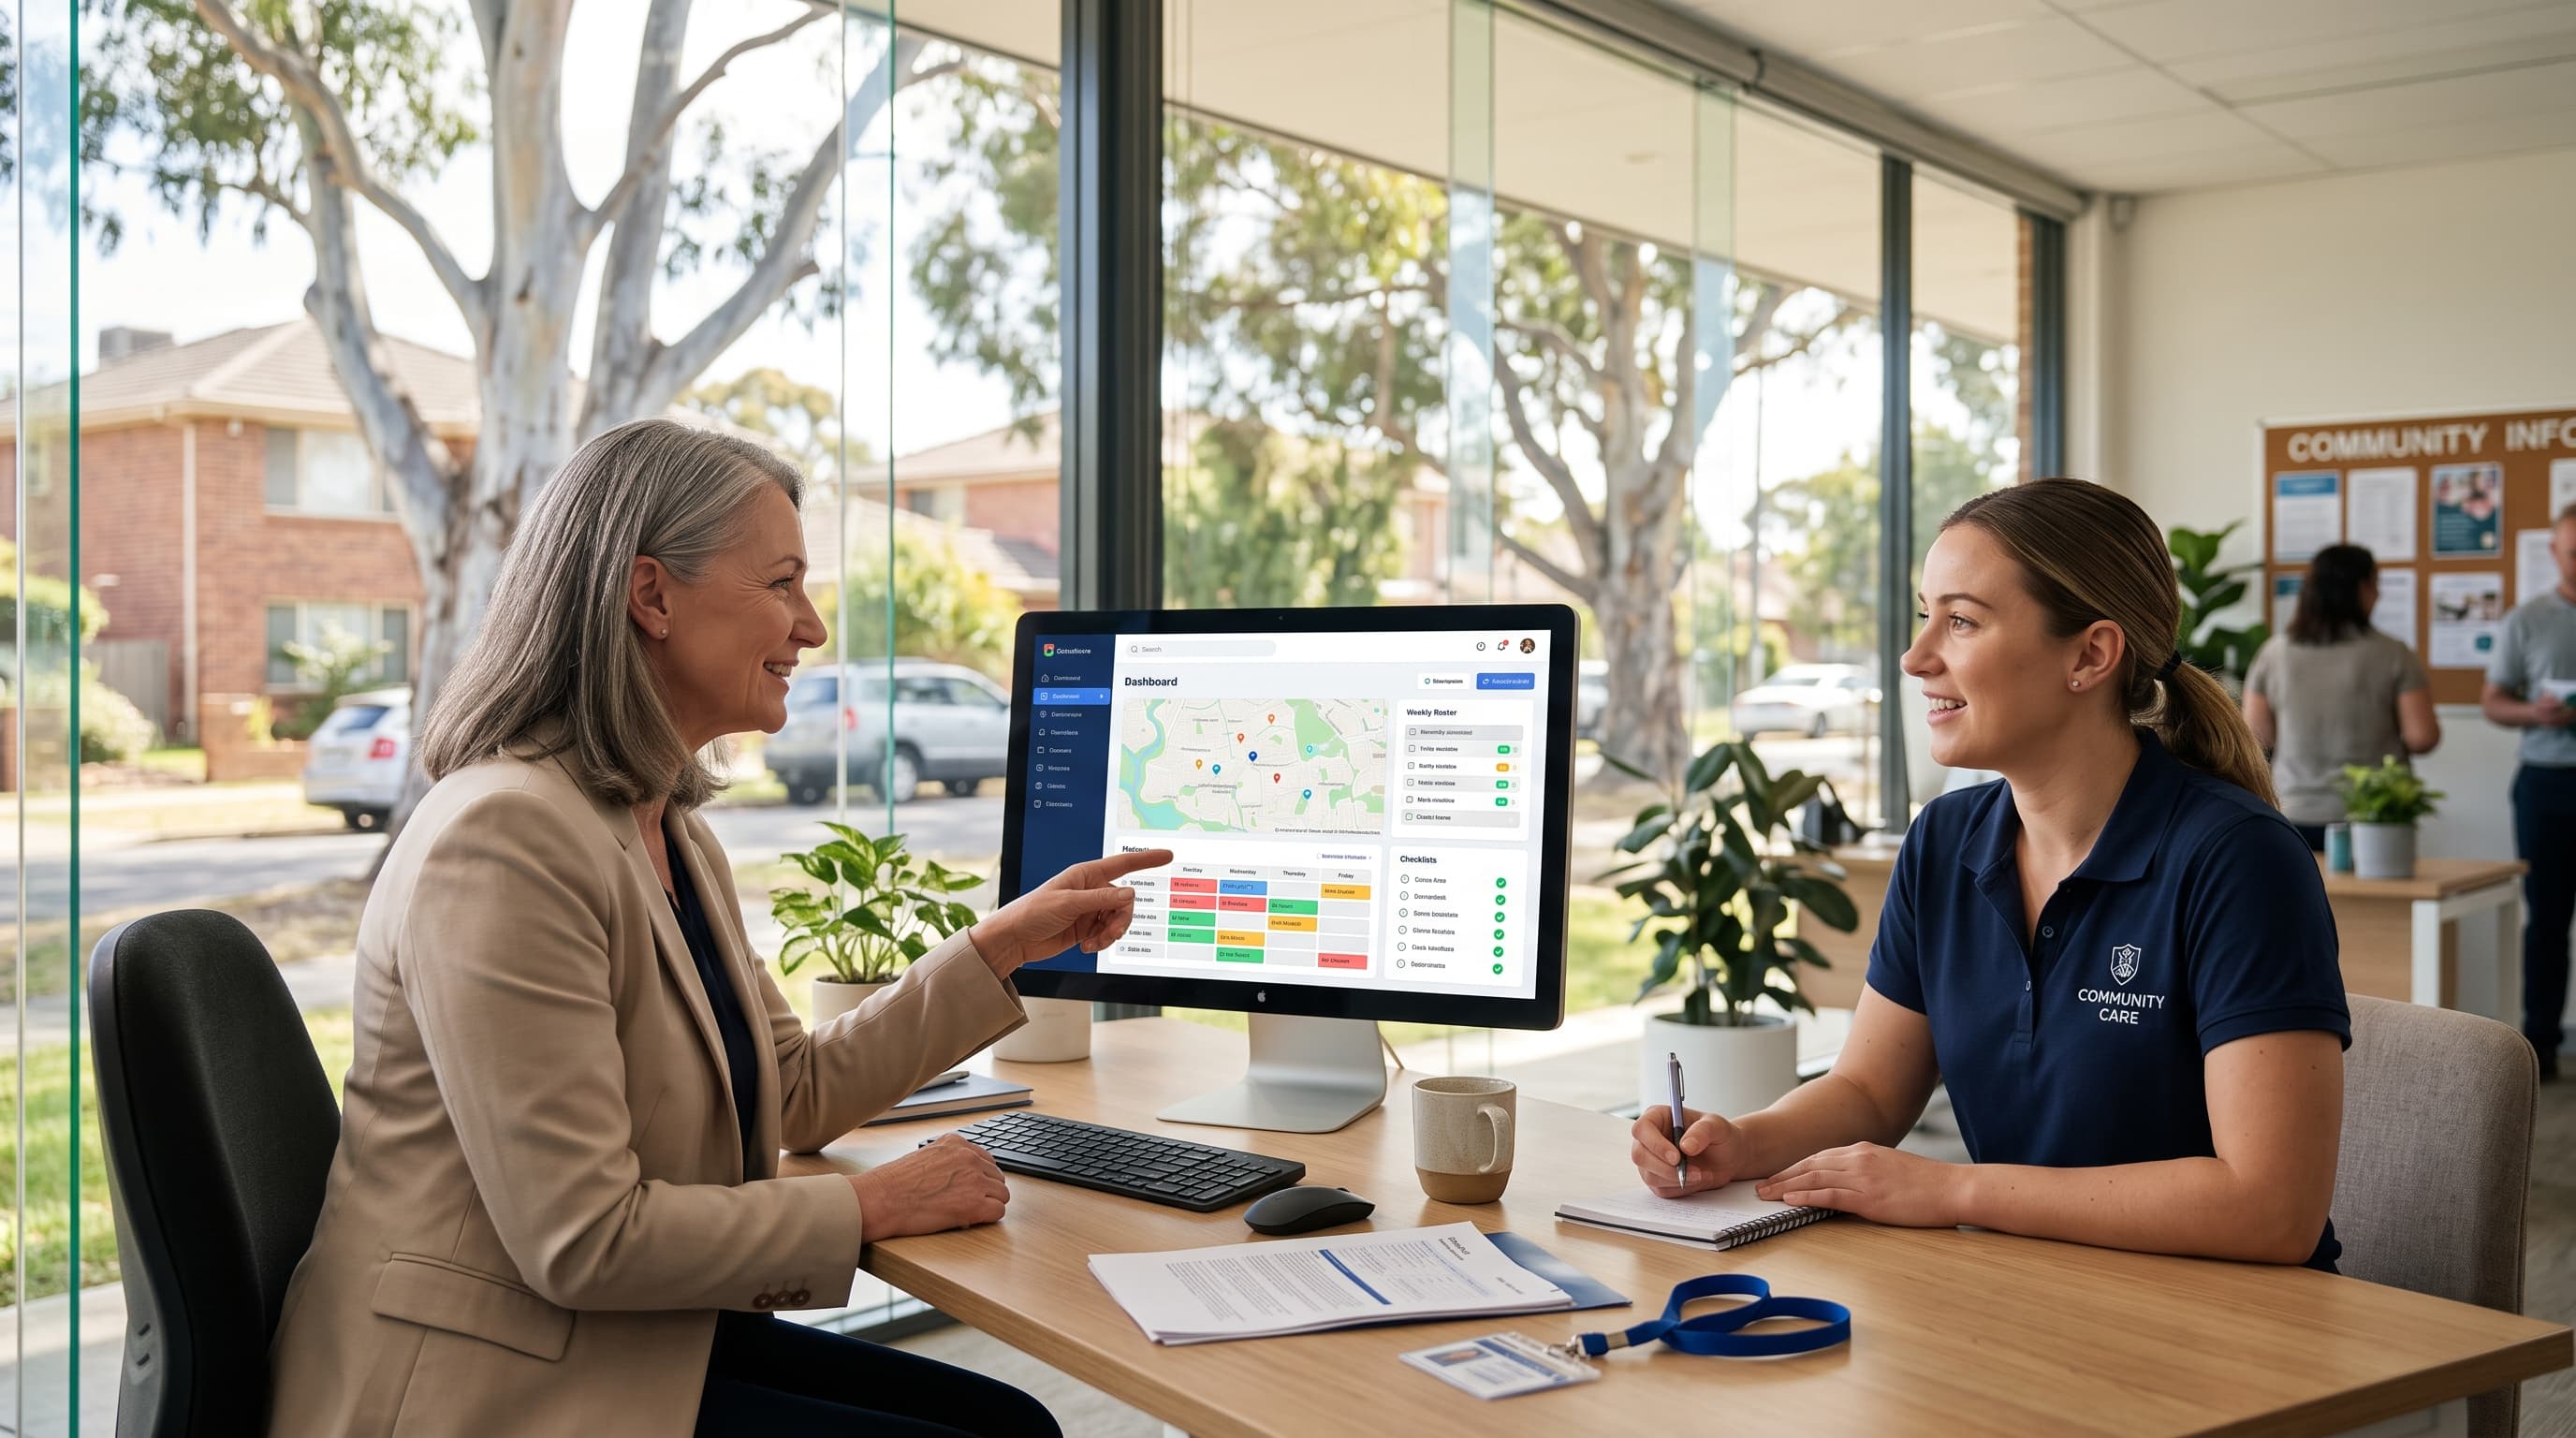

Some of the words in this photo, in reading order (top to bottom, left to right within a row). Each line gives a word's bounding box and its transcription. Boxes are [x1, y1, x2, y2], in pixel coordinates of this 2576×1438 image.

[2287, 423, 2489, 462] COMMUNITY
[1124, 676, 1178, 686] Dashboard
[1406, 709, 1432, 717] Weekly
[1399, 855, 1438, 864] Checklists
[2078, 989, 2165, 1009] COMMUNITY
[2099, 1007, 2140, 1025] CARE
